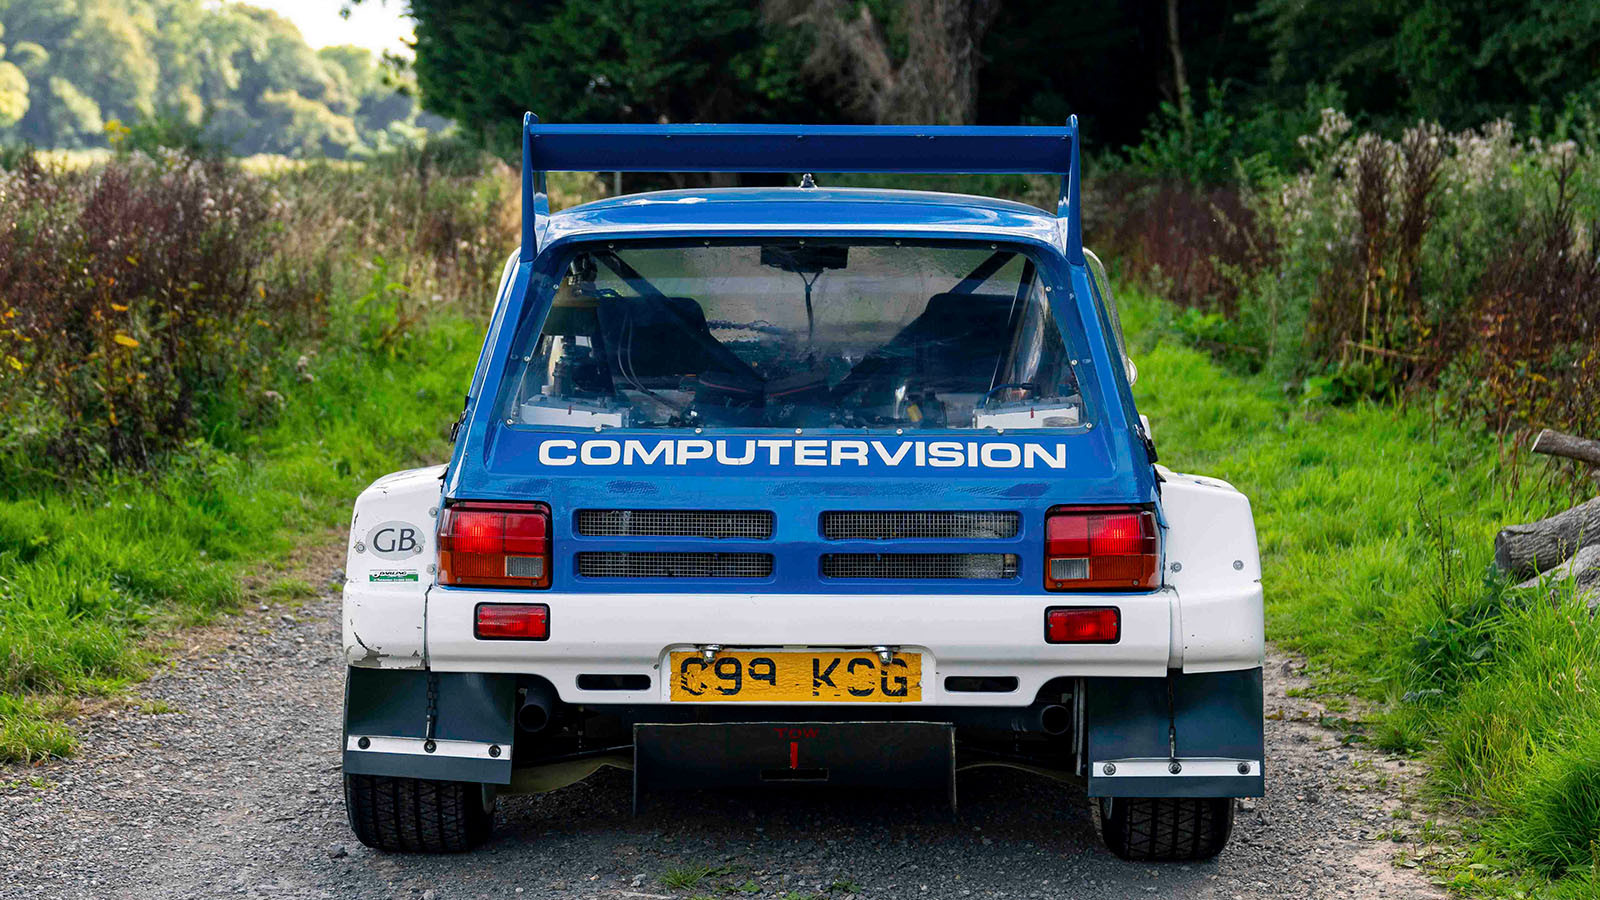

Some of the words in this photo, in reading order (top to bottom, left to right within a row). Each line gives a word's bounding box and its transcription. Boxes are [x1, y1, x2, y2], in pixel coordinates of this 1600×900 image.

[538, 438, 1067, 469] COMPUTERVISION
[373, 528, 417, 553] GB
[680, 657, 777, 696] C99
[772, 727, 820, 739] TOW
